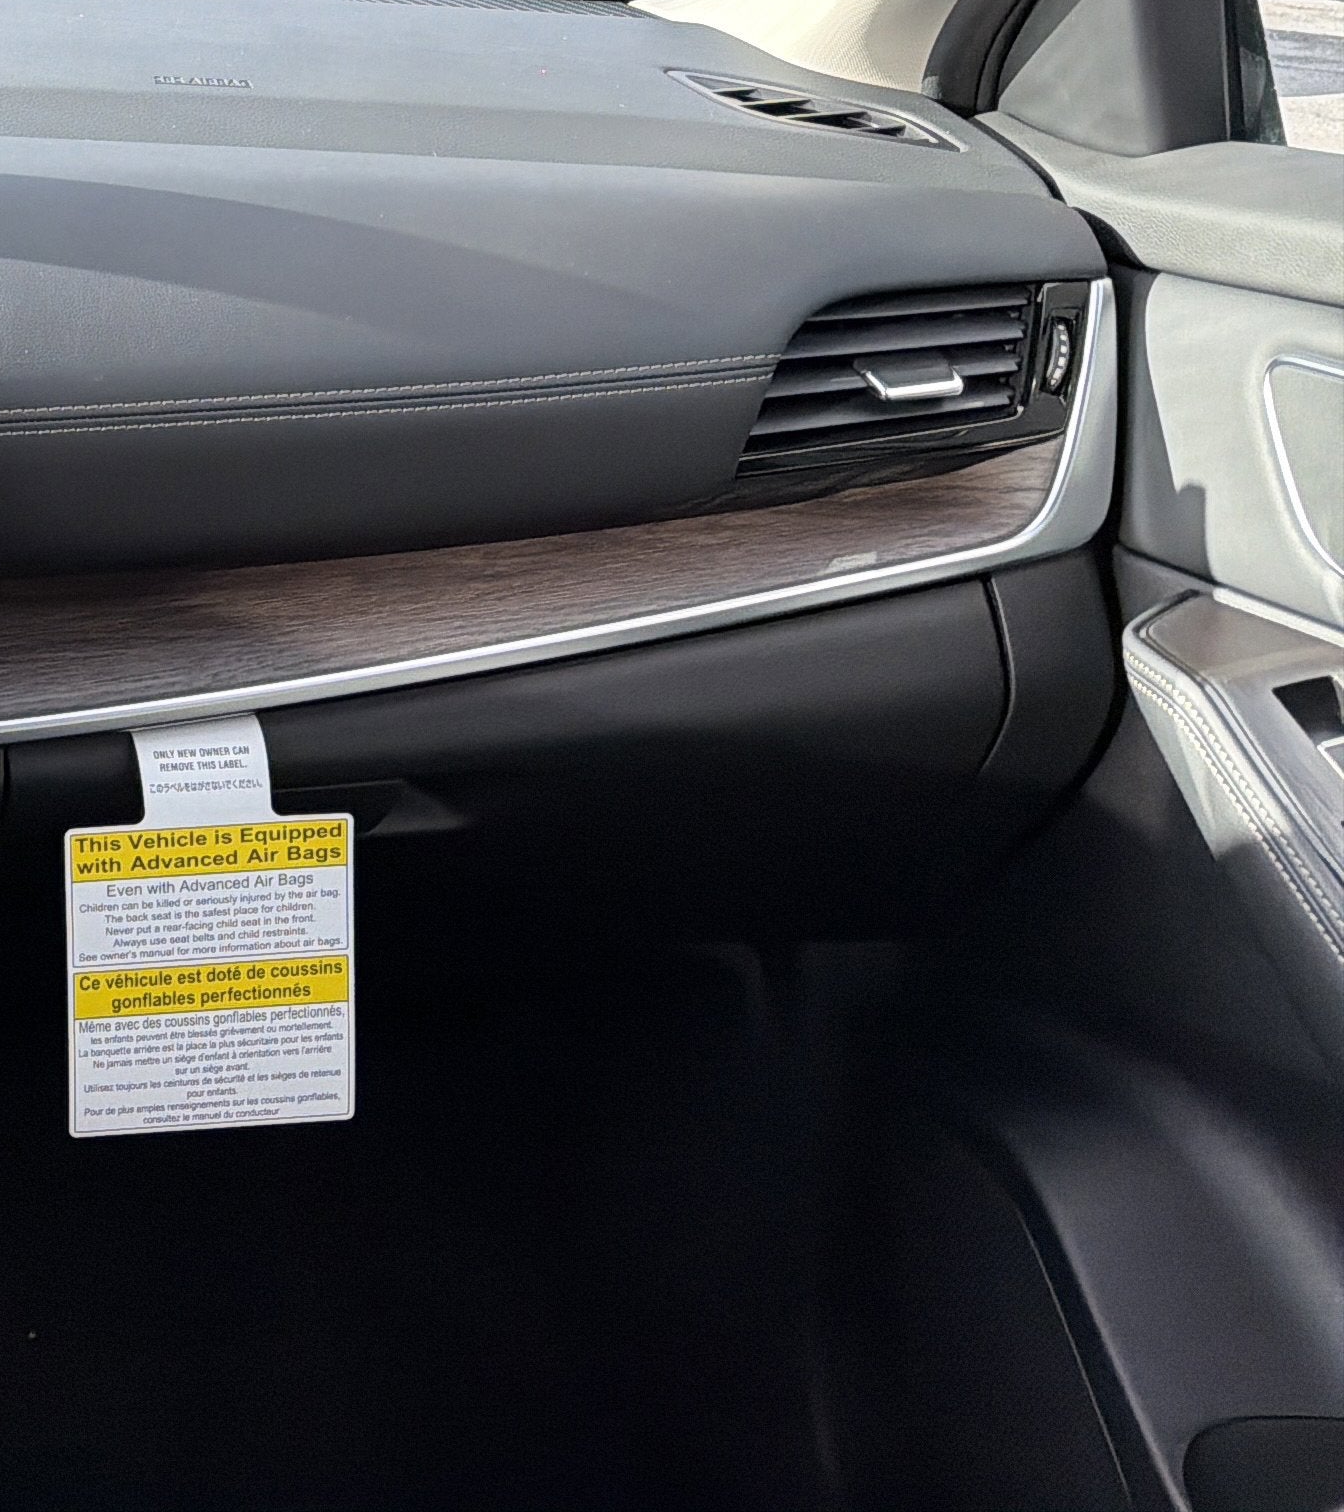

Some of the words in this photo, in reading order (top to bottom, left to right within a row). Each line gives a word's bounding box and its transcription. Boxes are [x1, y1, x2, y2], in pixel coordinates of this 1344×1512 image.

[152, 749, 174, 759] ONLY
[176, 748, 196, 758] NEW
[198, 746, 230, 757] OWNER
[231, 745, 249, 755] CAN
[159, 761, 195, 772] REMOVE
[196, 760, 216, 770] THIS
[217, 759, 247, 769] LABEL.
[74, 837, 122, 854] This
[128, 833, 208, 850] Vehicle
[214, 832, 232, 846] is
[240, 822, 342, 848] Equipped
[76, 857, 121, 874] with
[130, 850, 237, 870] Advanced
[246, 847, 279, 863] Air
[286, 845, 341, 862] Bags
[106, 884, 142, 897] Even
[146, 881, 175, 894] with
[178, 876, 249, 892] Advanced
[253, 874, 274, 888] Air
[278, 873, 313, 887] Bags
[78, 902, 119, 913] Children
[121, 902, 139, 910] can
[155, 897, 180, 907] killed
[195, 894, 238, 905] seriously
[239, 892, 271, 904] injured
[287, 890, 303, 899] the
[305, 889, 318, 898] air
[103, 914, 123, 923] The
[125, 912, 148, 922] back
[150, 911, 171, 920] seat
[184, 909, 199, 918] the
[201, 907, 230, 917] safest
[232, 906, 258, 916] place
[260, 904, 274, 913] for
[78, 952, 97, 962] See
[139, 947, 174, 958] manual
[176, 946, 190, 955] for
[191, 946, 216, 954] more
[218, 941, 271, 952] information
[273, 938, 300, 948] about
[302, 937, 315, 947] air
[79, 975, 100, 990] Ce
[104, 971, 172, 988] véhicule
[176, 969, 202, 984] est
[205, 966, 241, 982] doté
[246, 964, 265, 979] de
[270, 960, 342, 977] coussins
[111, 991, 195, 1013] gonflables
[200, 983, 311, 1006] perfectionnés
[114, 1020, 140, 1031] avec
[141, 1017, 161, 1029] des
[164, 1014, 210, 1027] coussins
[212, 1010, 267, 1027] gonflables
